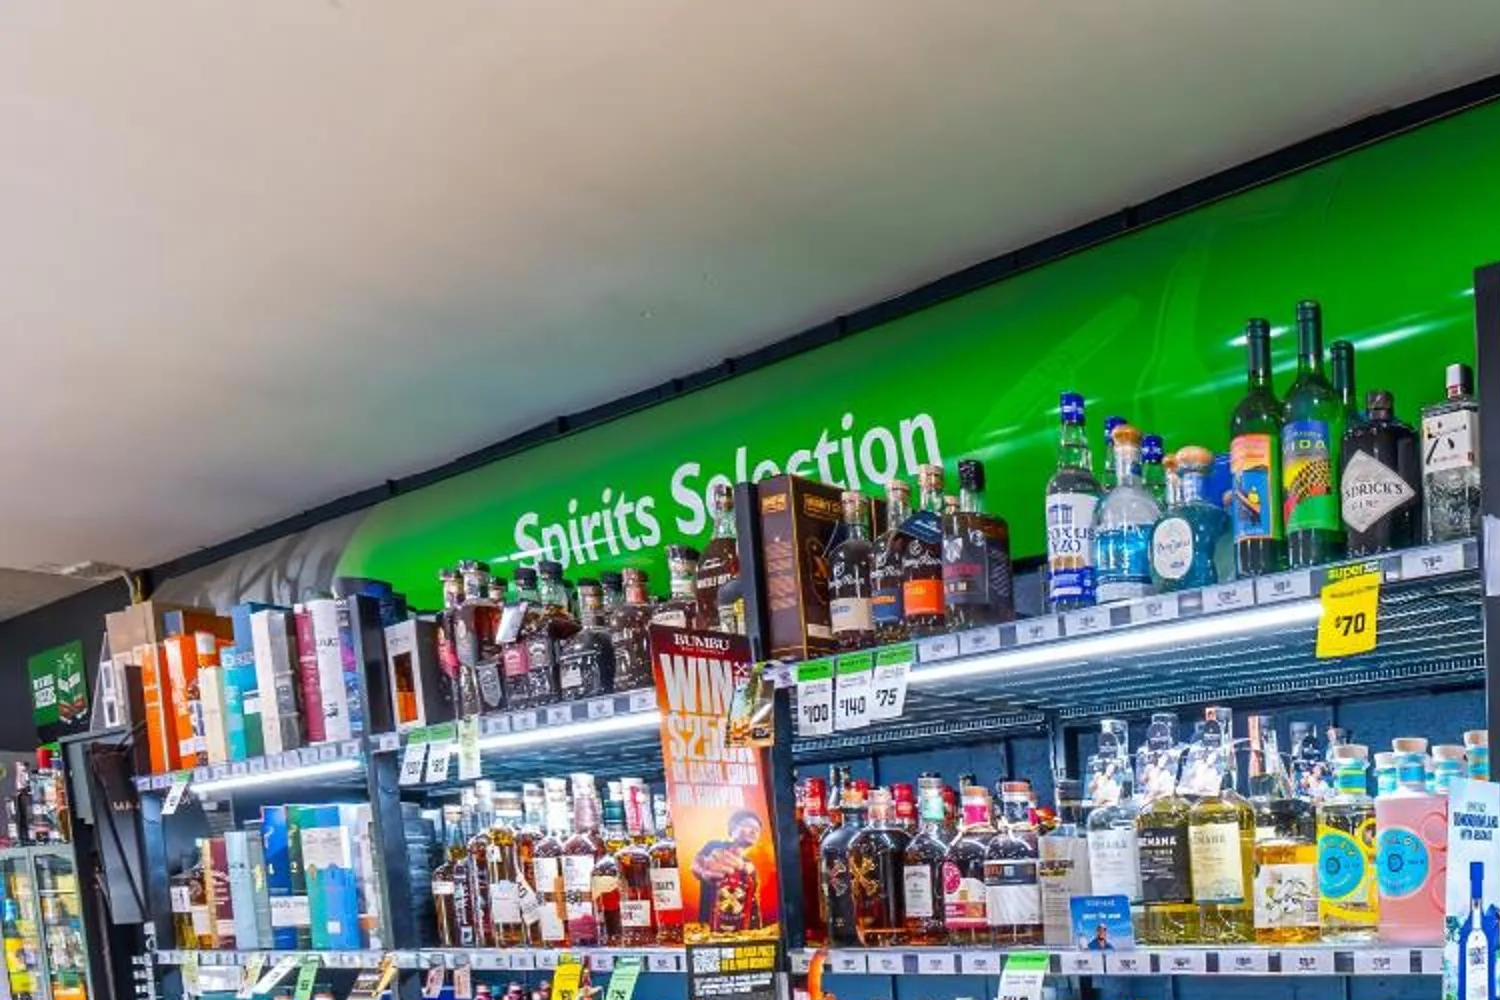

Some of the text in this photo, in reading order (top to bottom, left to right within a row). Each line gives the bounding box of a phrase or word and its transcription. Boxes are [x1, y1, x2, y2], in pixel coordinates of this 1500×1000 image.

[513, 486, 662, 570] Spirits
[1335, 612, 1367, 637] $70
[673, 633, 731, 650] BUMBU
[659, 652, 735, 714] WIN
[840, 694, 867, 718] $140
[875, 688, 897, 708] $75
[803, 704, 829, 723] $100
